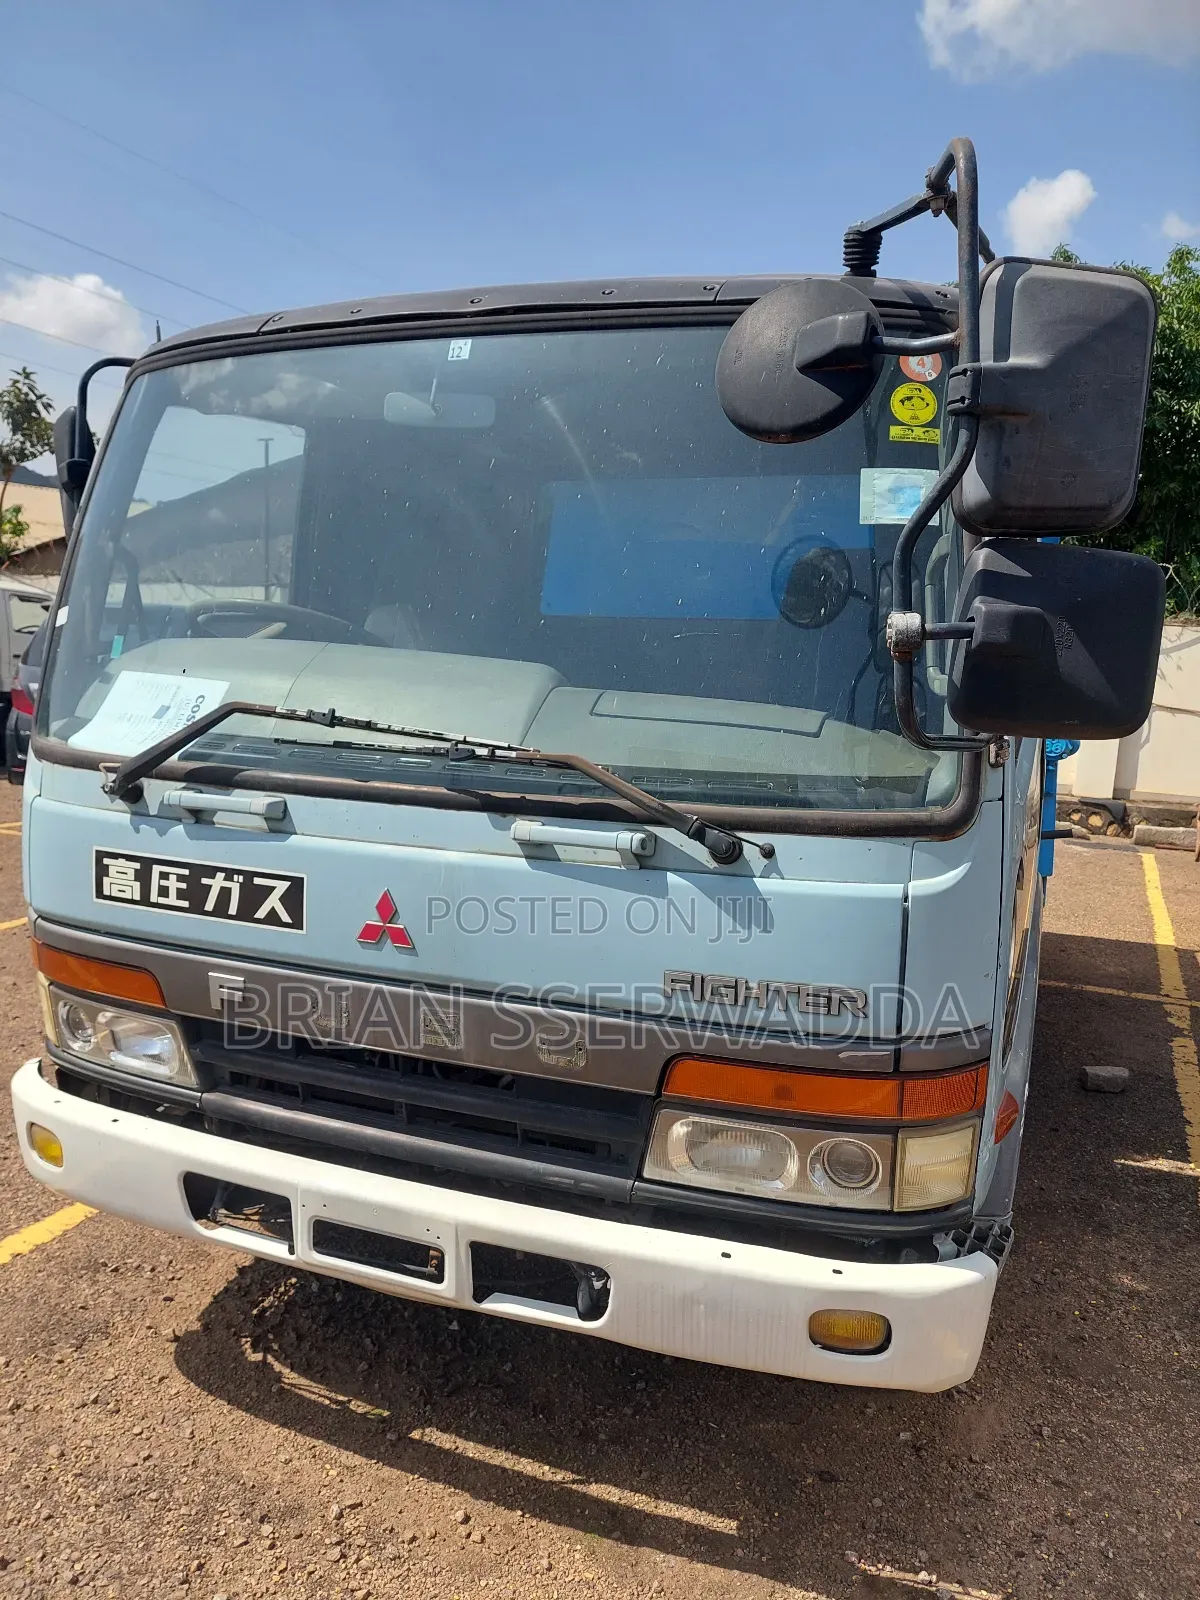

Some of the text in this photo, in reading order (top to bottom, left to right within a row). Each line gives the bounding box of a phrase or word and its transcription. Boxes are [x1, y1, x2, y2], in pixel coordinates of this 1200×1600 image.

[449, 346, 463, 359] 12
[103, 858, 293, 923] 高圧ガス
[664, 970, 868, 1019] FIGHTER
